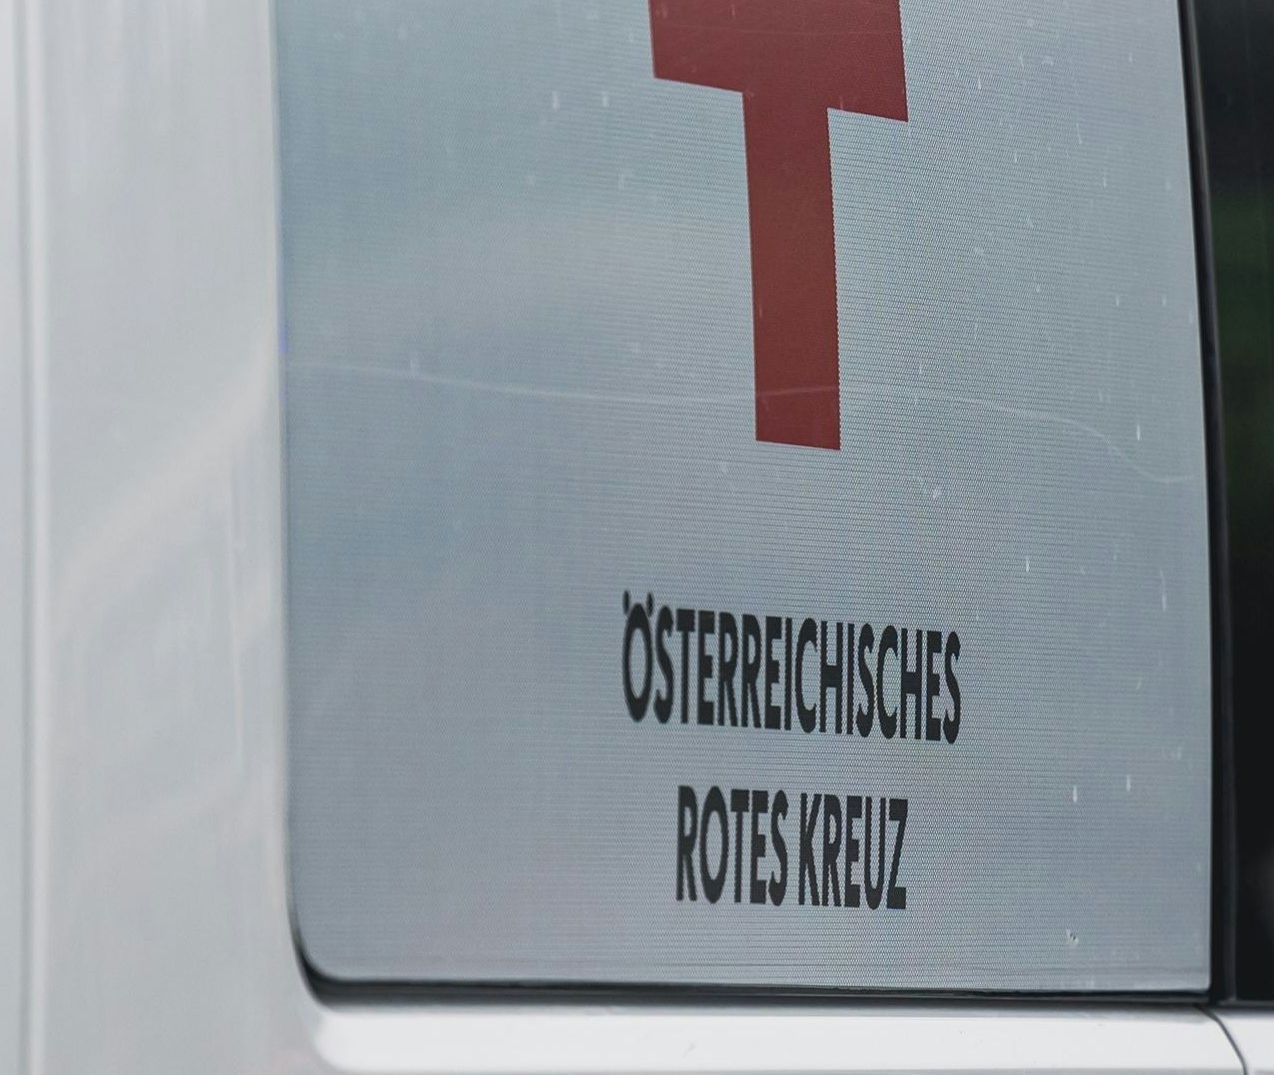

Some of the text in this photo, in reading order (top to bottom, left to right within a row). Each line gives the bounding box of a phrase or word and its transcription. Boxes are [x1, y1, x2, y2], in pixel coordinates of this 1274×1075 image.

[621, 589, 963, 745] ÖSTERREICHISCHES
[675, 784, 909, 910] ROTES KREUZ
